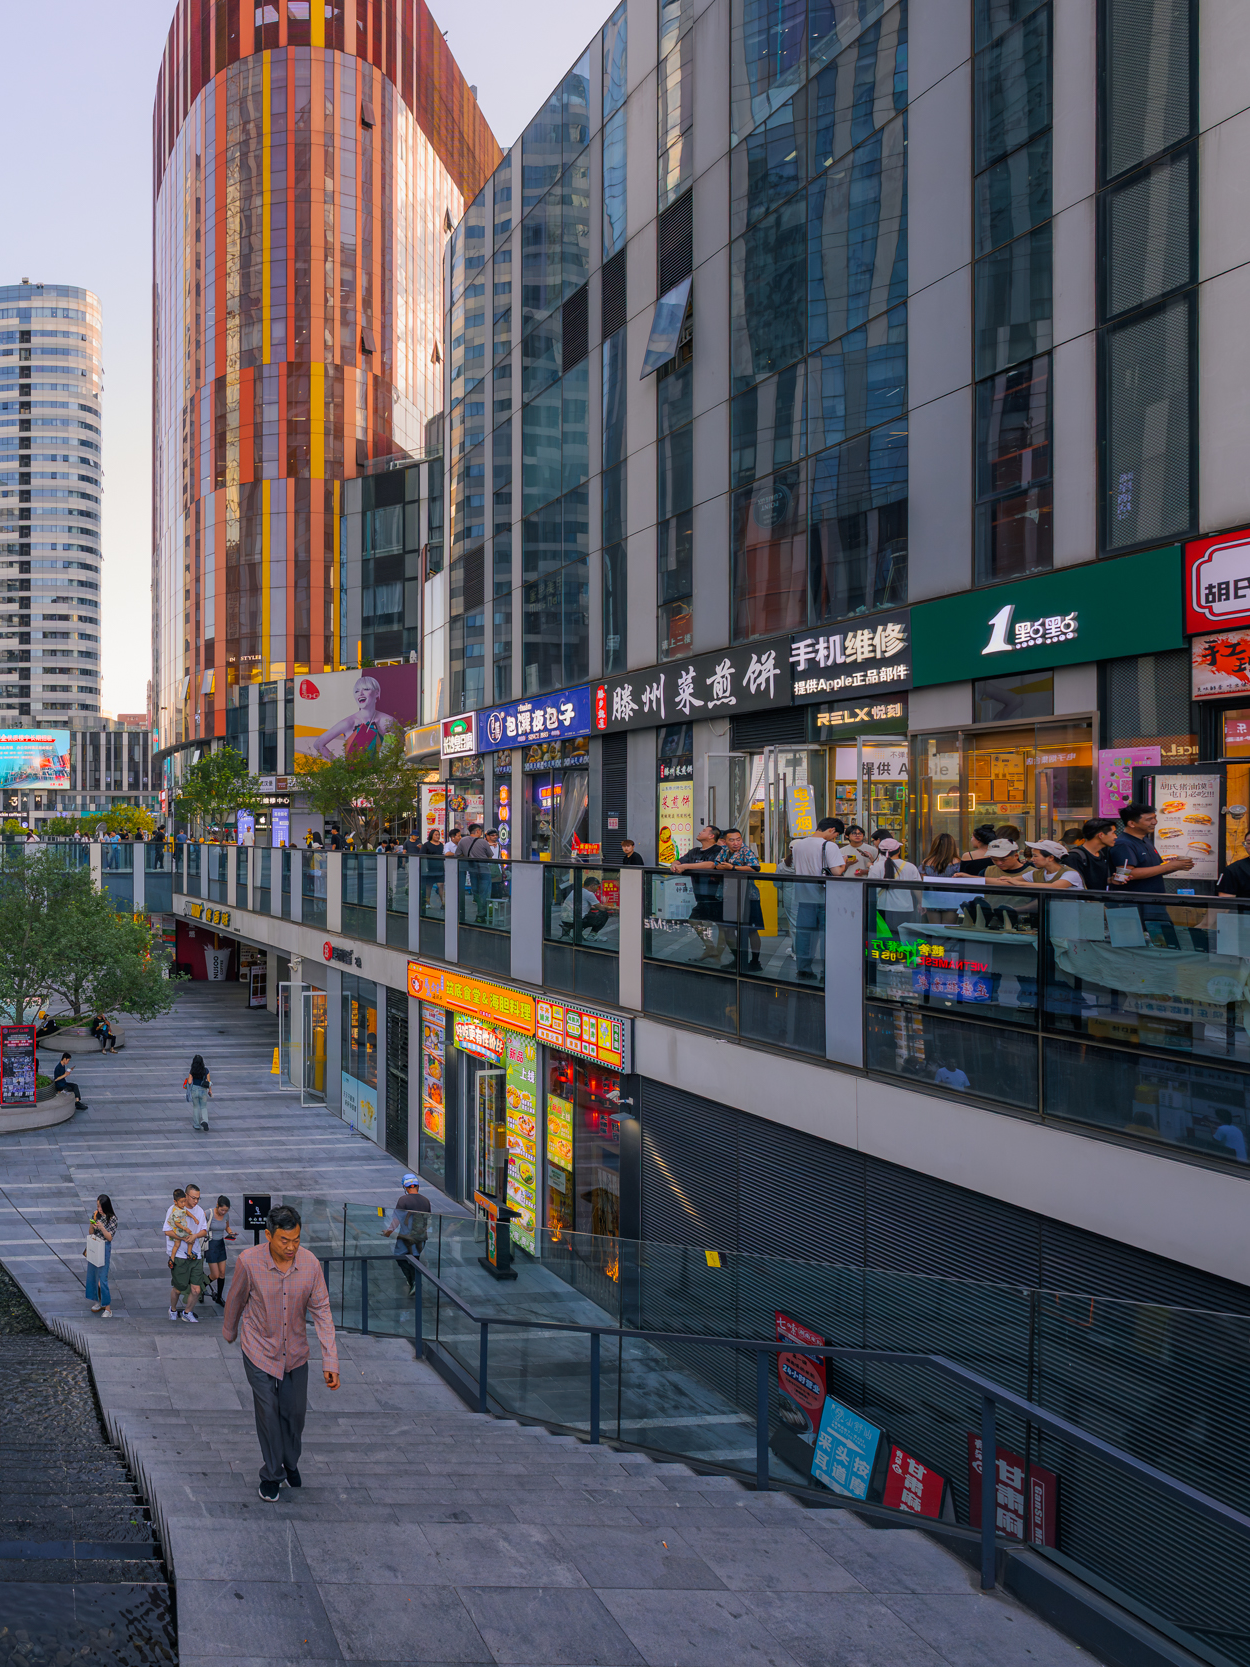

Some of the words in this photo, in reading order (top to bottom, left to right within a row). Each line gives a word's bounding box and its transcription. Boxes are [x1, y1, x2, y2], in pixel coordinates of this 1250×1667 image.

[789, 623, 908, 672] 手机维修
[612, 650, 781, 722] 滕州菜煎饼
[794, 664, 909, 696] 提供Apple正品部件
[817, 707, 870, 727] RELX
[871, 702, 903, 721] 悦刻
[443, 732, 473, 755] 长沙臭豆腐
[862, 762, 892, 776] 提供
[793, 787, 812, 831] 电子烟
[508, 1047, 523, 1063] 新品
[782, 1363, 820, 1395] 24小时营业
[814, 1431, 832, 1471] 采耳
[849, 1457, 870, 1497] 按摩
